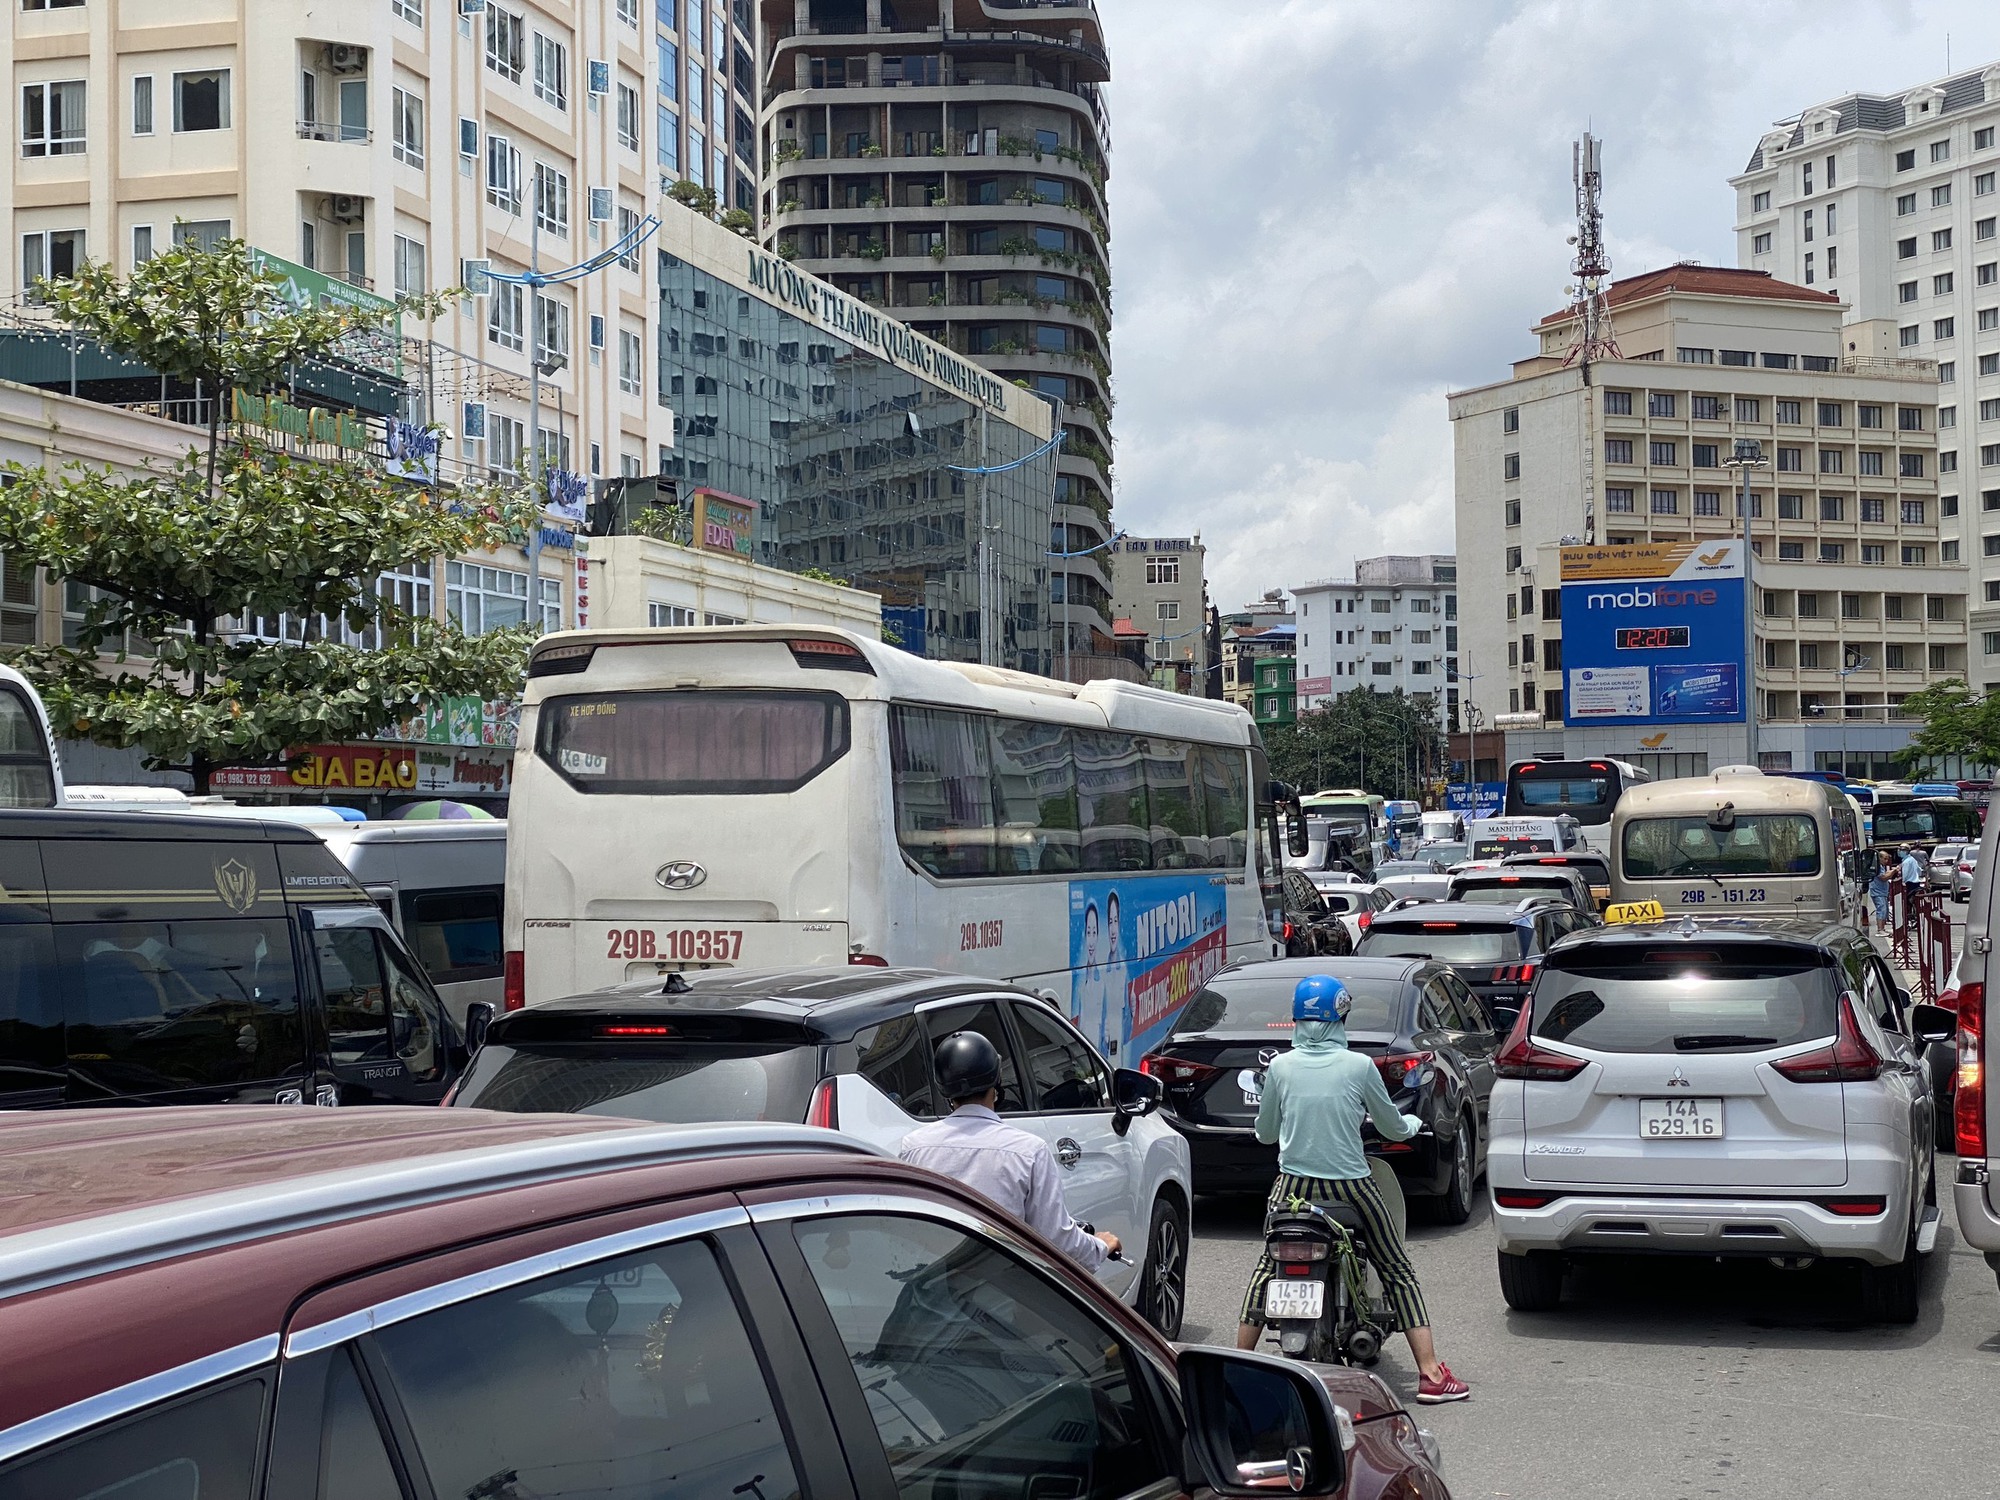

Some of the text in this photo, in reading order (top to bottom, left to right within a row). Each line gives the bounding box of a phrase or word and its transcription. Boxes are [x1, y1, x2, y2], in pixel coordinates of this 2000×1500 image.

[820, 287, 880, 347] THANH
[881, 322, 931, 373] QUẢNG
[933, 347, 967, 394] NINH
[968, 367, 1007, 412] HOTEL
[705, 523, 736, 551] EDEN
[1155, 540, 1190, 552] HOTEL
[1636, 550, 1659, 558] NAM
[1588, 586, 1717, 609] mobifone
[1626, 628, 1668, 647] 12:20
[570, 705, 580, 717] XE
[292, 749, 418, 788] GIA BẢO
[227, 773, 244, 784] 0982
[245, 774, 258, 784] 122
[259, 774, 272, 785] 622
[1484, 791, 1499, 801] 24H
[285, 876, 350, 886] LIMITED EDITION
[1681, 890, 1705, 903] 29B
[1722, 889, 1766, 903] 151.23
[1614, 903, 1656, 919] TAXI
[1137, 891, 1197, 962] NITORI
[961, 919, 1003, 951] 29B.10357
[1169, 957, 1188, 1005] 2000
[363, 1066, 402, 1080] TRANSIT
[1665, 1100, 1699, 1117] 14A
[1650, 1118, 1714, 1135] 629.16
[1530, 1144, 1586, 1154] XPANDER
[1278, 1283, 1315, 1299] 14-B1
[1270, 1300, 1319, 1316] 375.24
